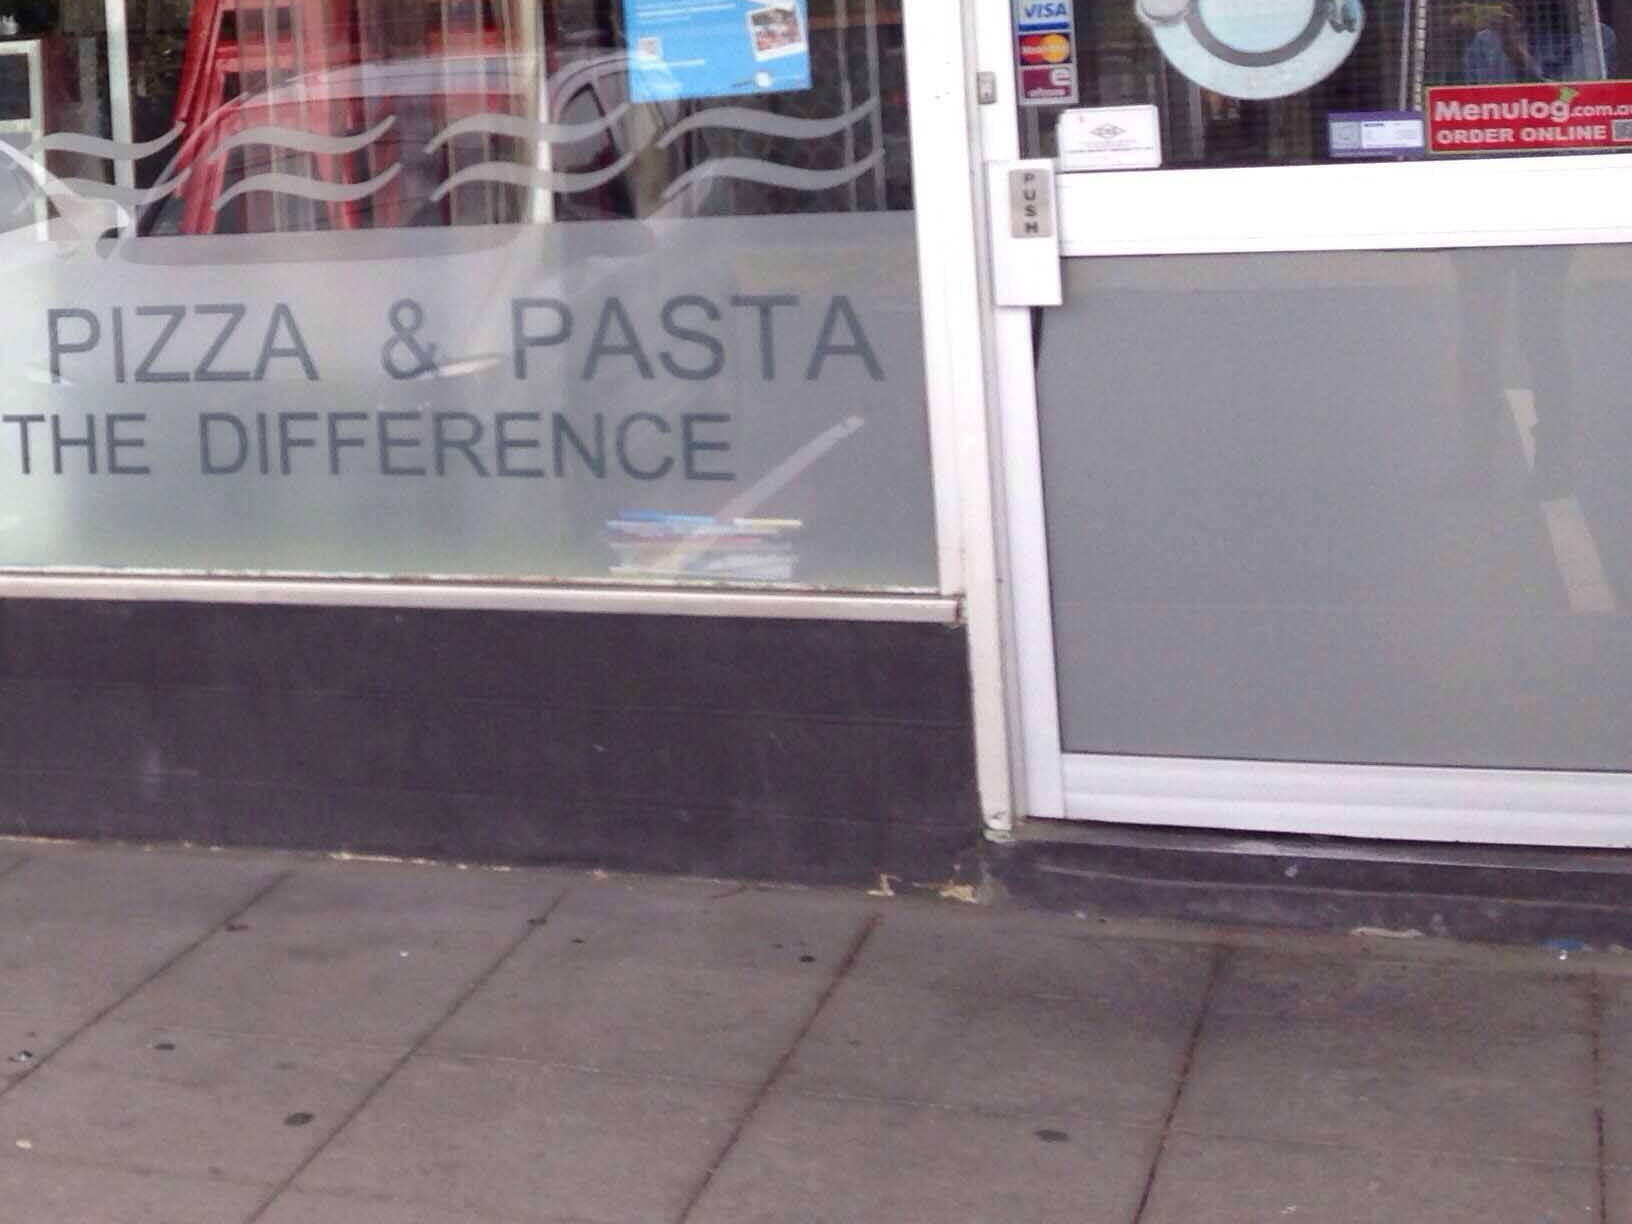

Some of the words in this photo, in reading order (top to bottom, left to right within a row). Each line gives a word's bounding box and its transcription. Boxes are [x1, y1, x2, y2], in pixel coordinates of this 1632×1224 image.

[1024, 3, 1067, 19] VISA
[1436, 127, 1514, 145] ORDER
[1521, 125, 1606, 143] ONLINE
[1023, 172, 1039, 233] PUSH
[47, 302, 320, 385] PIZZA
[380, 298, 437, 380] &
[510, 294, 886, 382] PASTA
[2, 412, 151, 476] THE
[198, 411, 737, 480] DIFFERENCE
